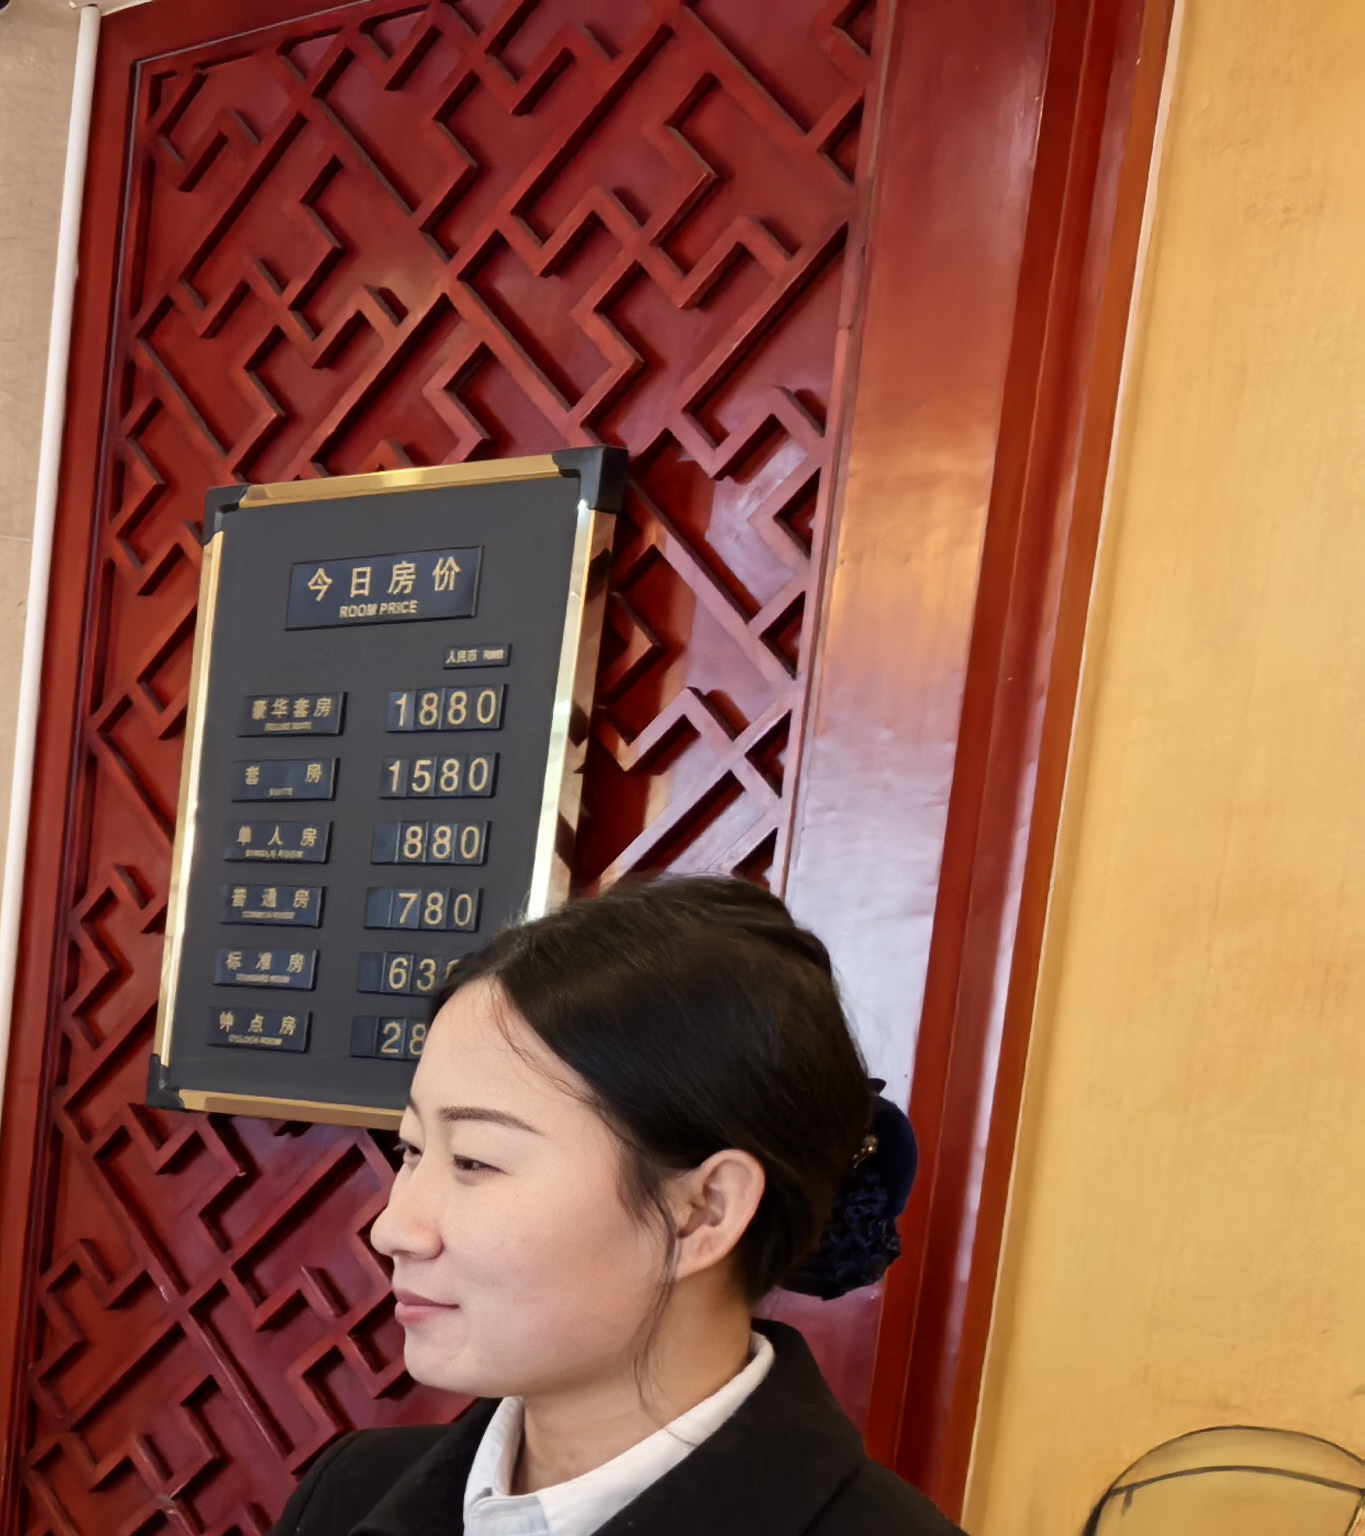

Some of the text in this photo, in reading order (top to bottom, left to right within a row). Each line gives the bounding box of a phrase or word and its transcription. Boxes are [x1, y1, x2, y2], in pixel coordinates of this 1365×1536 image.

[307, 556, 462, 602] 今日房价
[339, 599, 418, 619] ROOM PRICE
[251, 697, 333, 720] 豪华套房
[394, 689, 497, 728] 1880
[388, 757, 489, 793] 1580
[403, 825, 480, 860] 880
[231, 886, 311, 909] 普通房
[397, 891, 473, 926] 780
[226, 951, 306, 974] 标准房
[380, 1021, 426, 1055] 28
